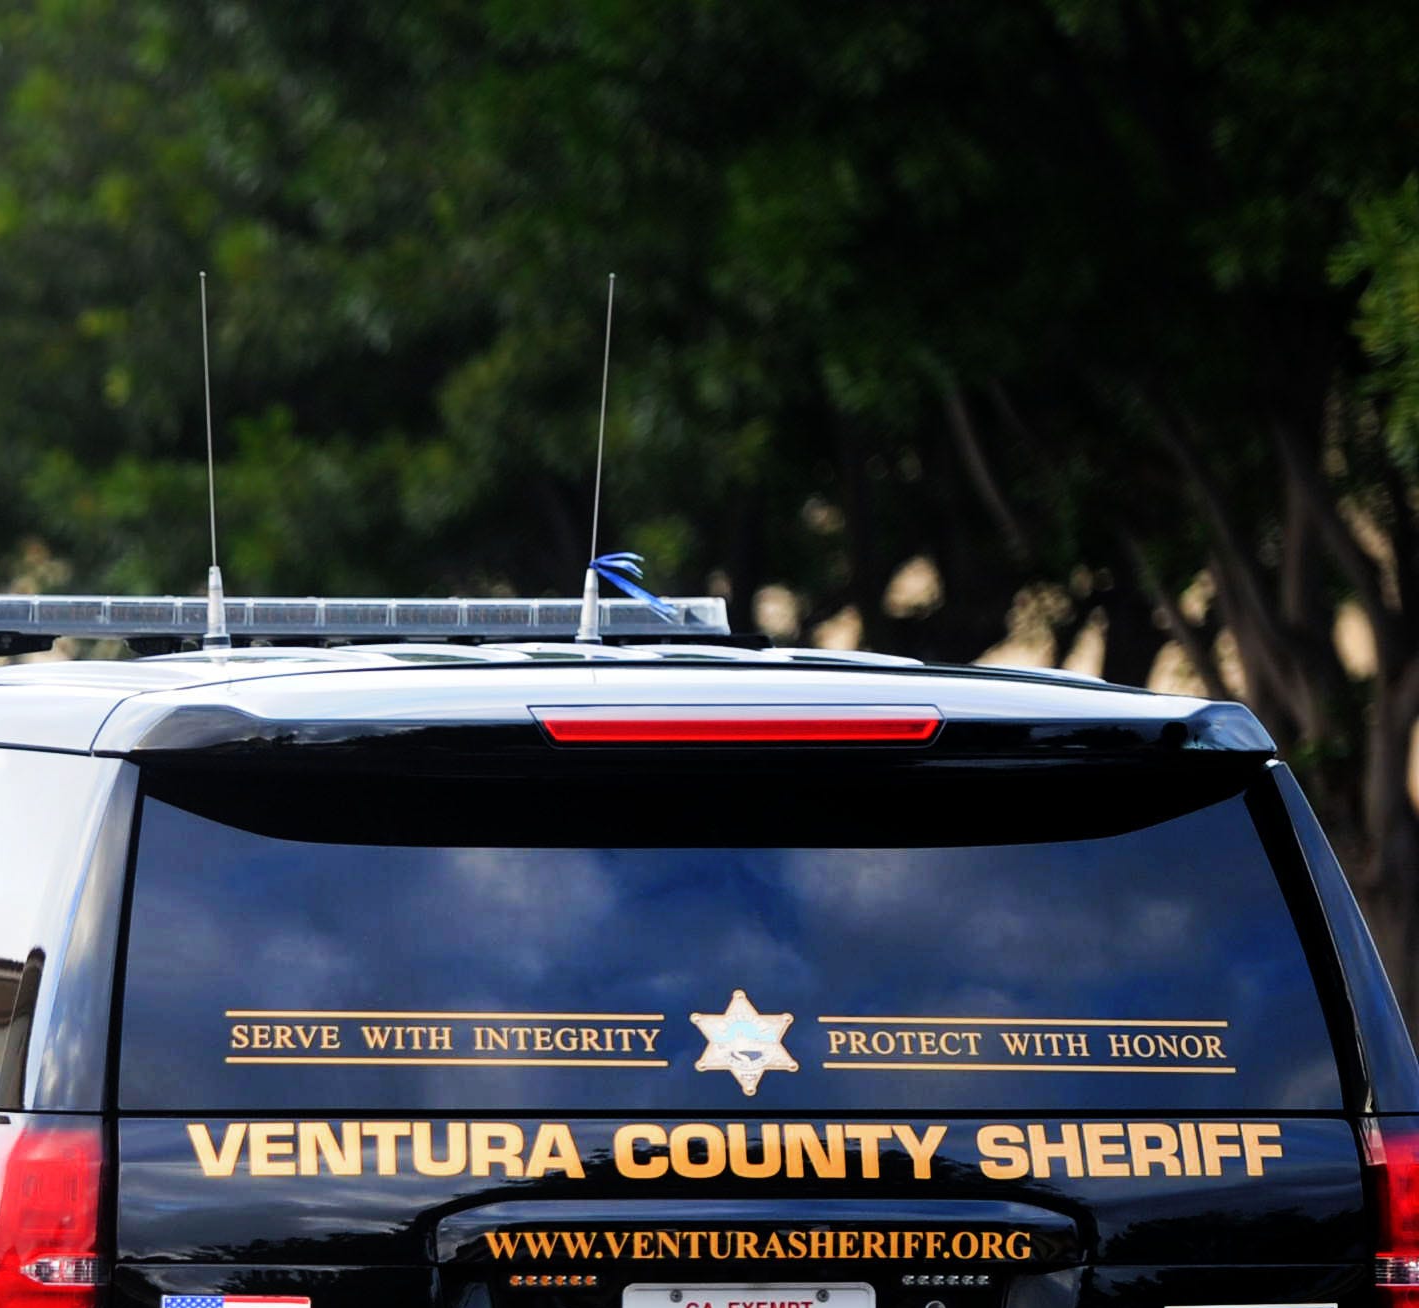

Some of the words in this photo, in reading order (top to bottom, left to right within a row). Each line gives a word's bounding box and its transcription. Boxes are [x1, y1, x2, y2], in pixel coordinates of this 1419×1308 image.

[231, 1023, 341, 1050] SERVE
[362, 1025, 453, 1050] WITH
[474, 1026, 660, 1053] INTEGRITY
[828, 1029, 983, 1057] PROTECT
[1001, 1031, 1091, 1058] WITH
[1109, 1033, 1228, 1060] HONOR
[187, 1120, 586, 1178] VENTURA
[612, 1122, 947, 1178] COUNTY
[975, 1122, 1283, 1178] SHERIFF
[485, 1231, 1032, 1261] WWW.VENTURASHERIFF.ORG
